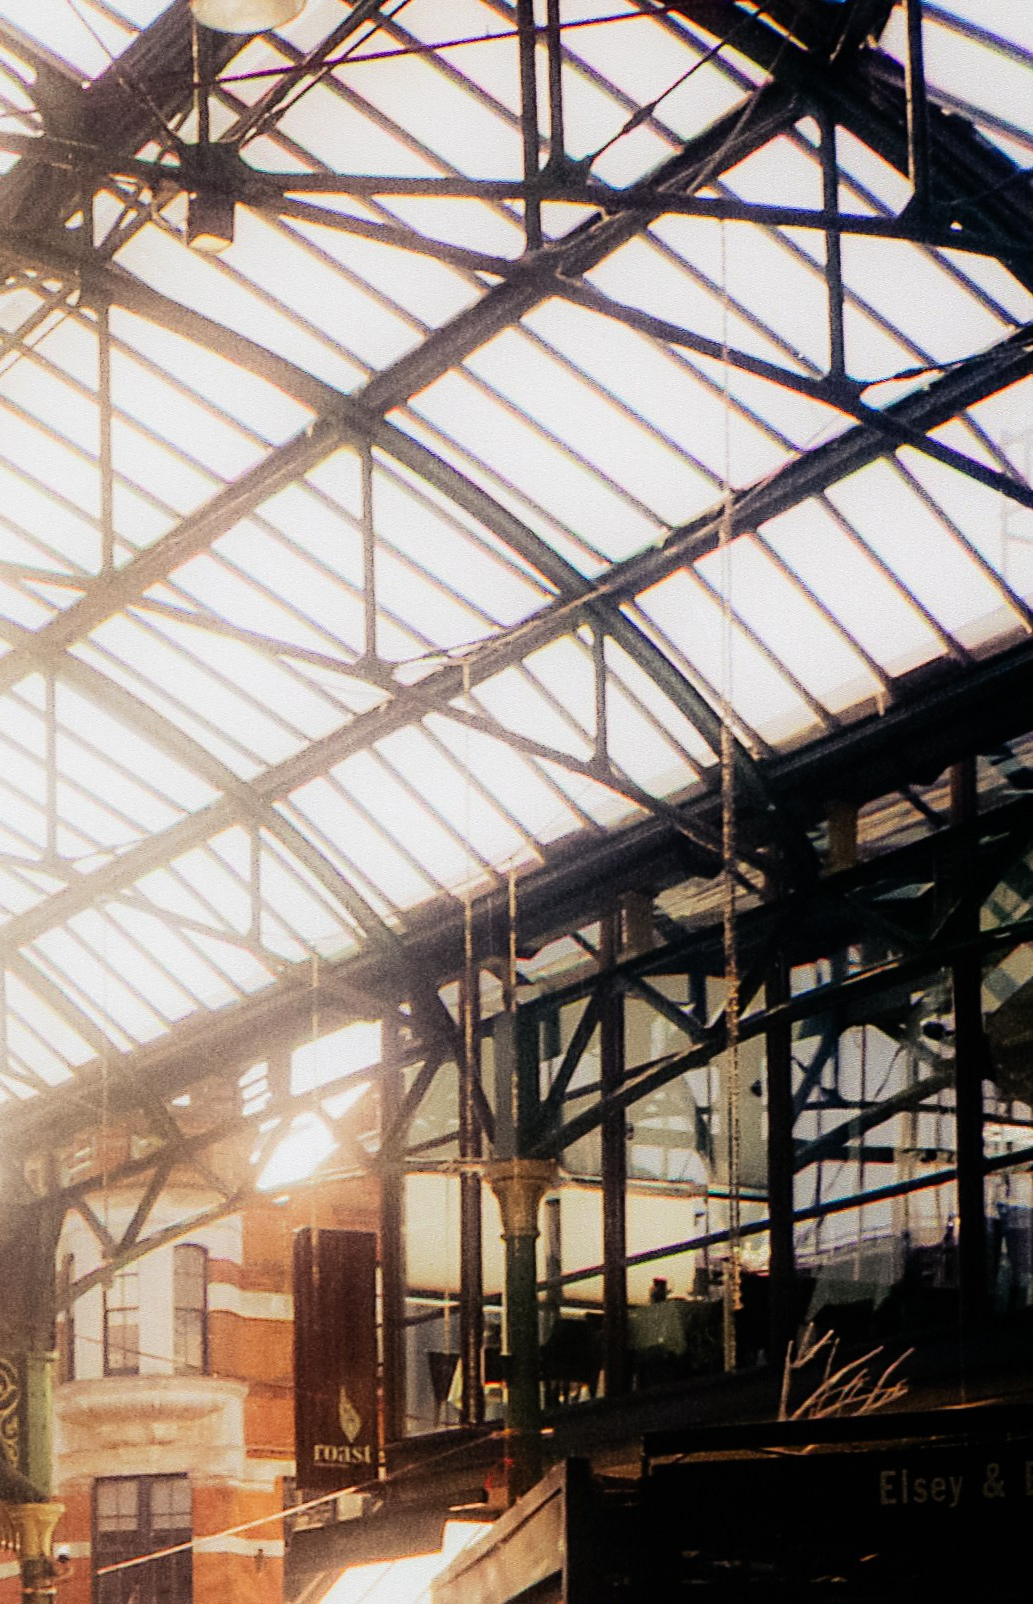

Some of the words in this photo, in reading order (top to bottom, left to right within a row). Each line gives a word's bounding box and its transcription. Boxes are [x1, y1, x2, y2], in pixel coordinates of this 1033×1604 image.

[313, 1444, 371, 1464] roast
[880, 1468, 963, 1508] Elsey
[982, 1462, 1006, 1498] &
